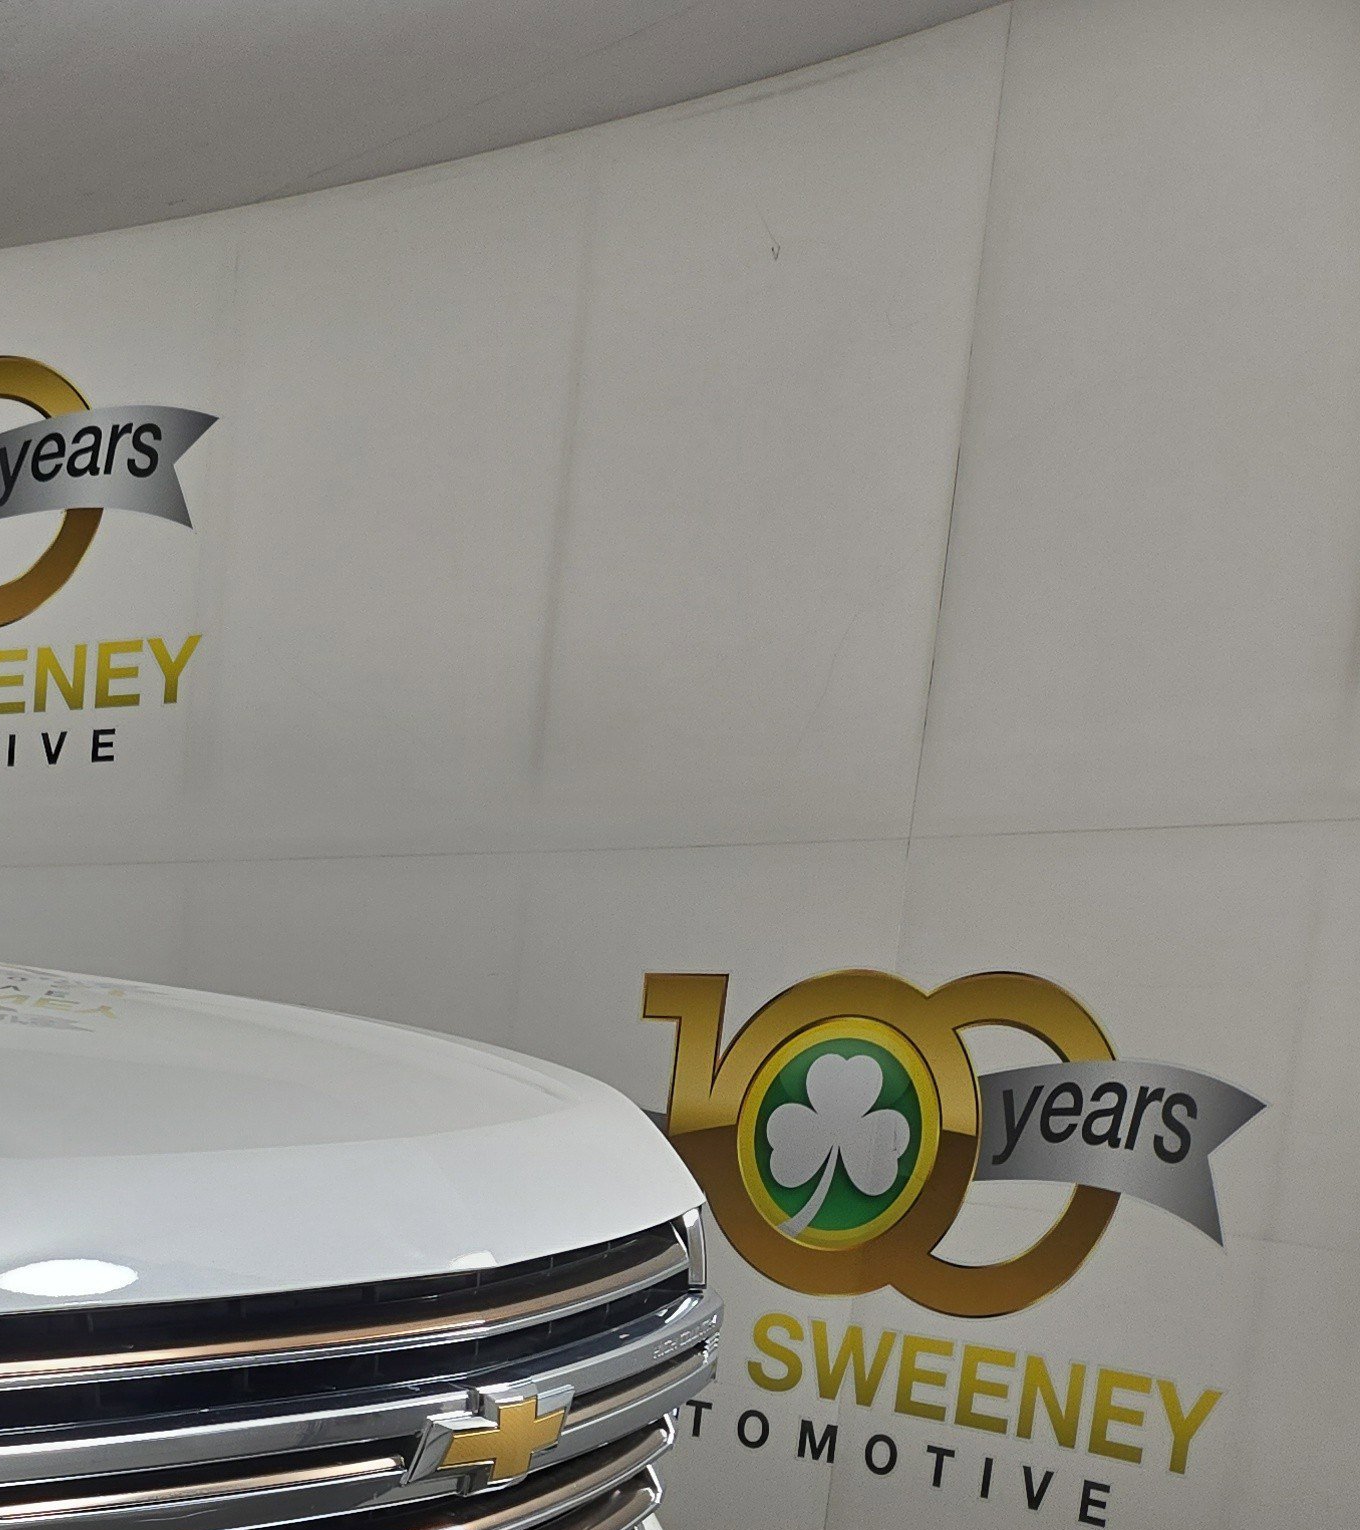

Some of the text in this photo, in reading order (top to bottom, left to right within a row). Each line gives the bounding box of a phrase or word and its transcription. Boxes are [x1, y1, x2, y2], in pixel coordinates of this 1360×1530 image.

[991, 1080, 1198, 1166] years
[747, 1313, 1224, 1475] SWEENEY
[685, 1399, 1112, 1528] TOMOTIVE
